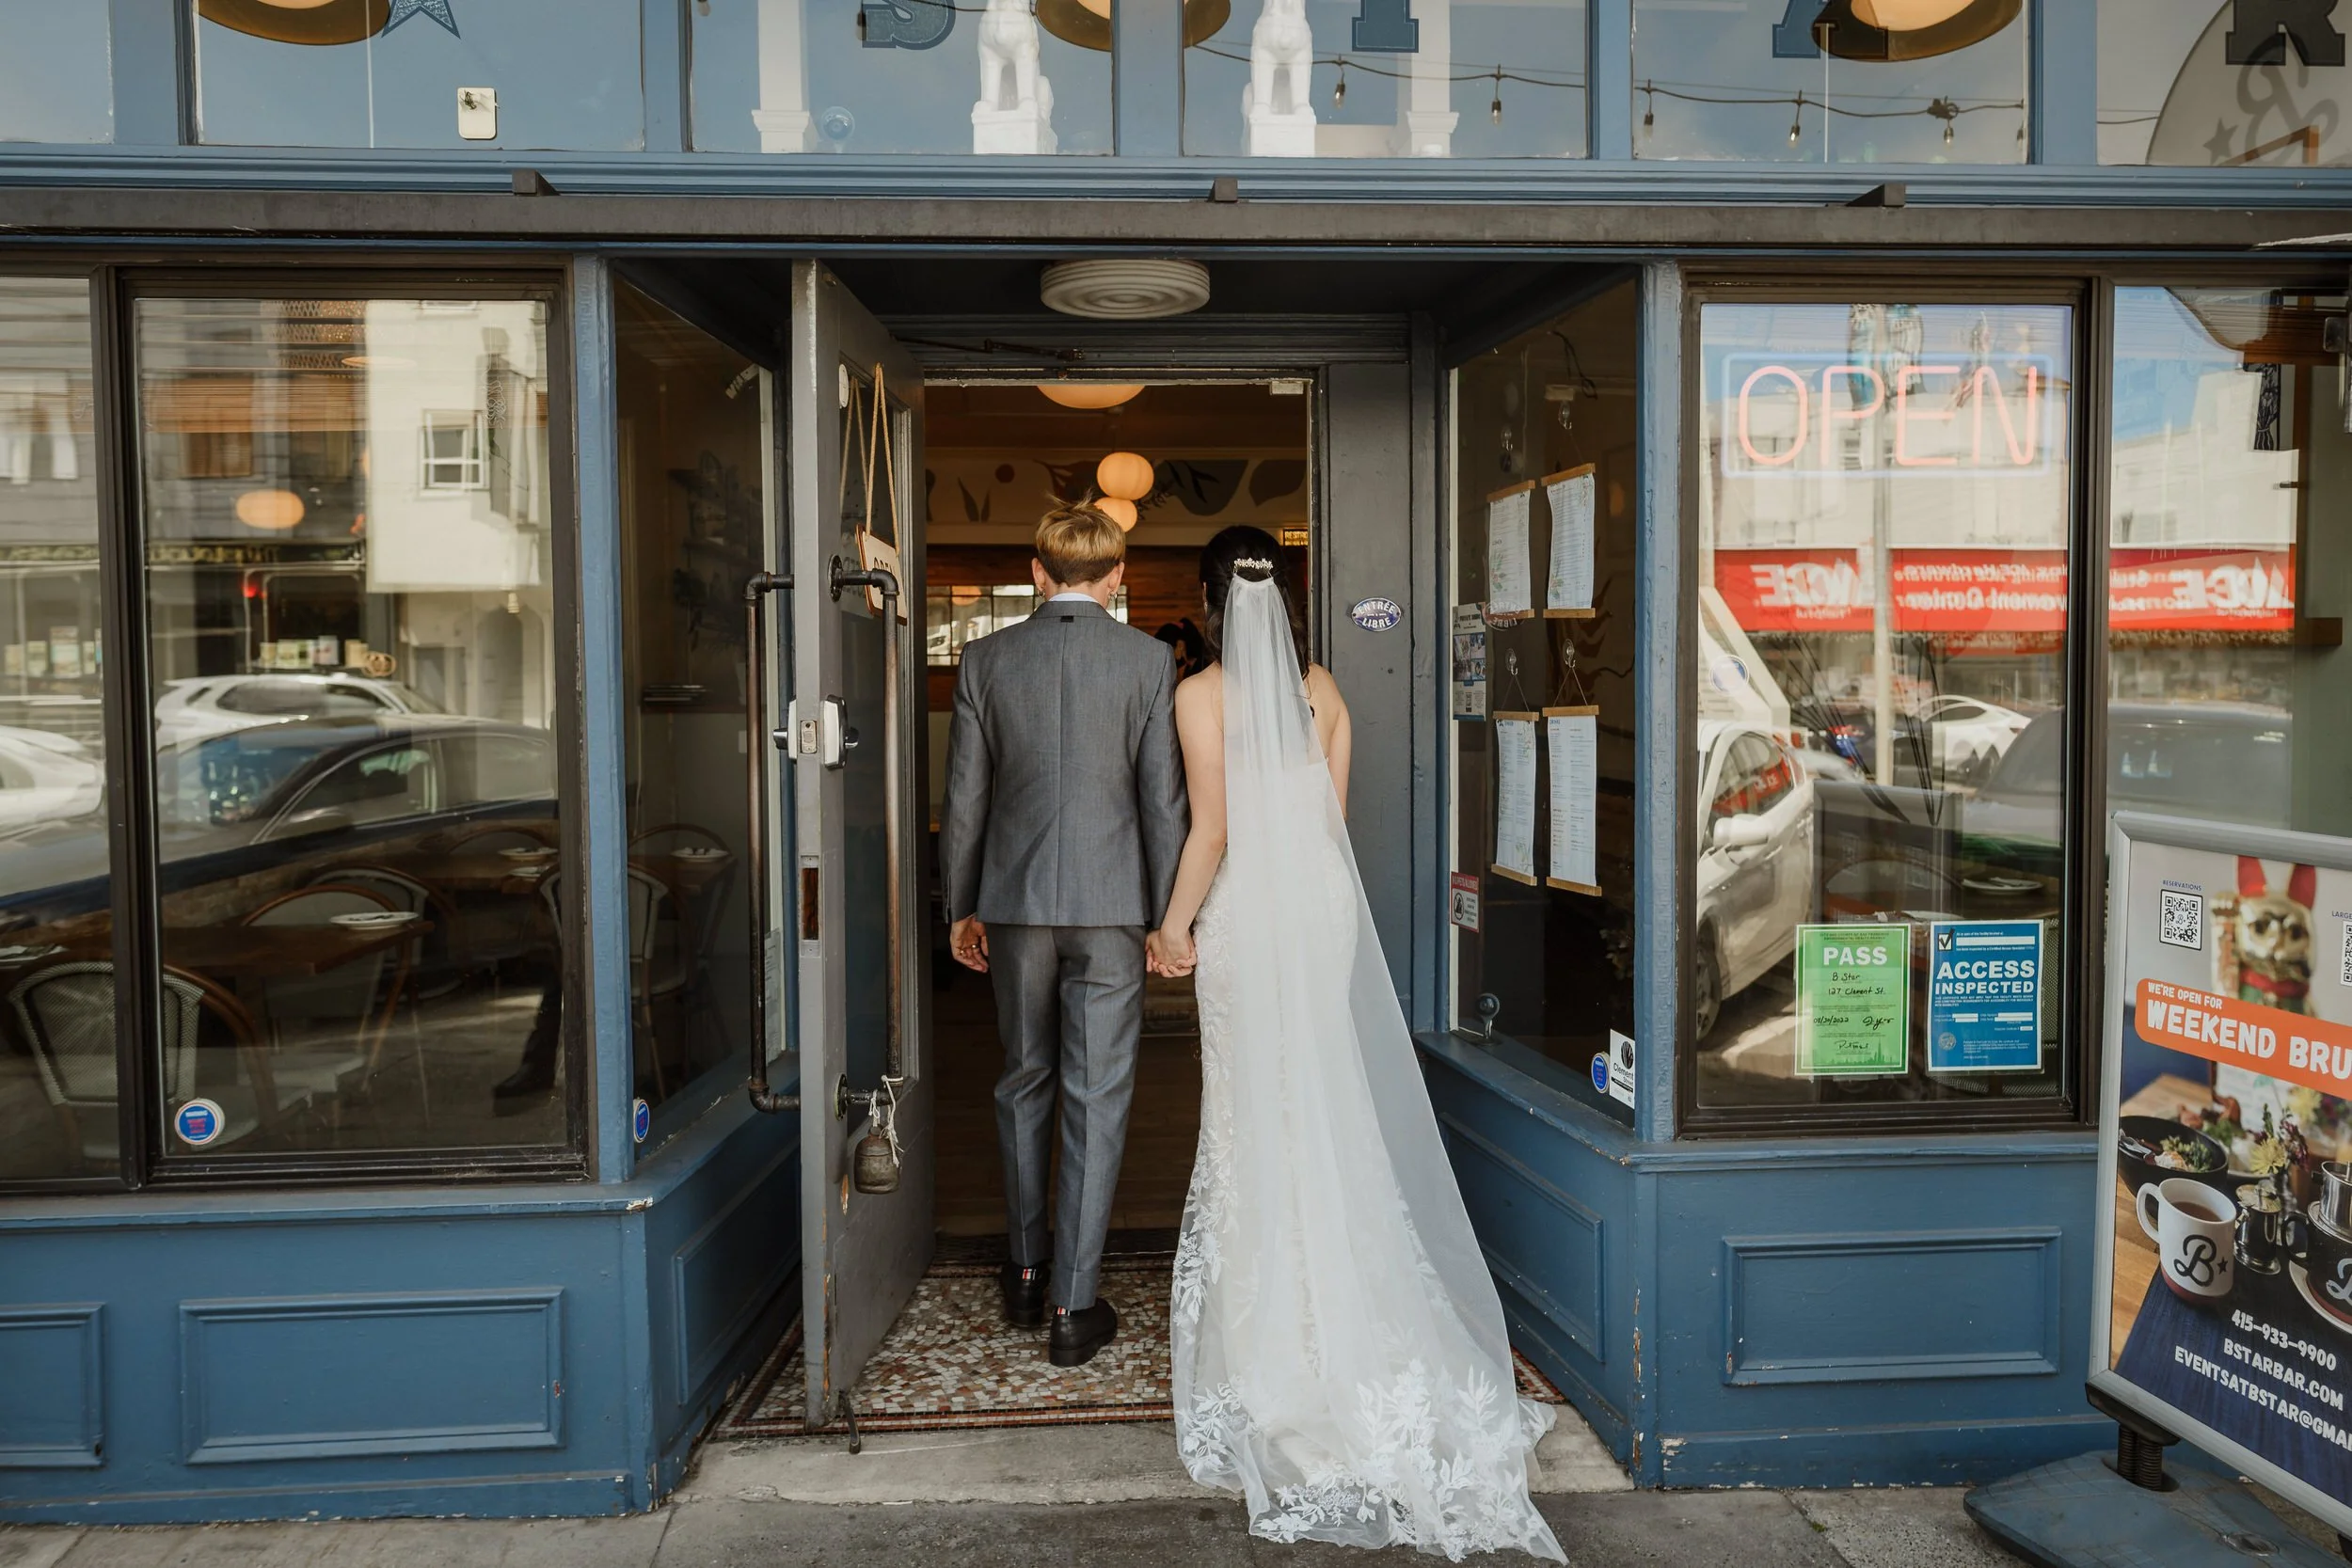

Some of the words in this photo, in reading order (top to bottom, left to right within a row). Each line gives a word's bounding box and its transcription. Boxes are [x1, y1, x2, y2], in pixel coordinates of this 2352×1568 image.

[1738, 365, 2037, 466] OPEN
[1358, 600, 1395, 614] ENTRÉE
[1361, 616, 1392, 629] LIBRE
[2163, 879, 2202, 892] RESERVATIONS
[1823, 946, 1887, 966] PASS
[1832, 972, 1838, 981] B
[1841, 973, 1861, 981] Star
[1936, 959, 2035, 979] ACCESS
[1845, 986, 1872, 995] Clement
[1934, 980, 2034, 995] INSPECTED
[2148, 981, 2175, 999] WE'RE
[2177, 989, 2201, 1006] OPEN
[2203, 995, 2223, 1009] FOR
[2147, 999, 2276, 1059] WEEKEND
[2289, 1036, 2352, 1080] BRU
[2173, 1234, 2217, 1287] B
[2231, 1308, 2337, 1371] 415-933-9900
[2223, 1338, 2344, 1411] BSTARBAR.COM
